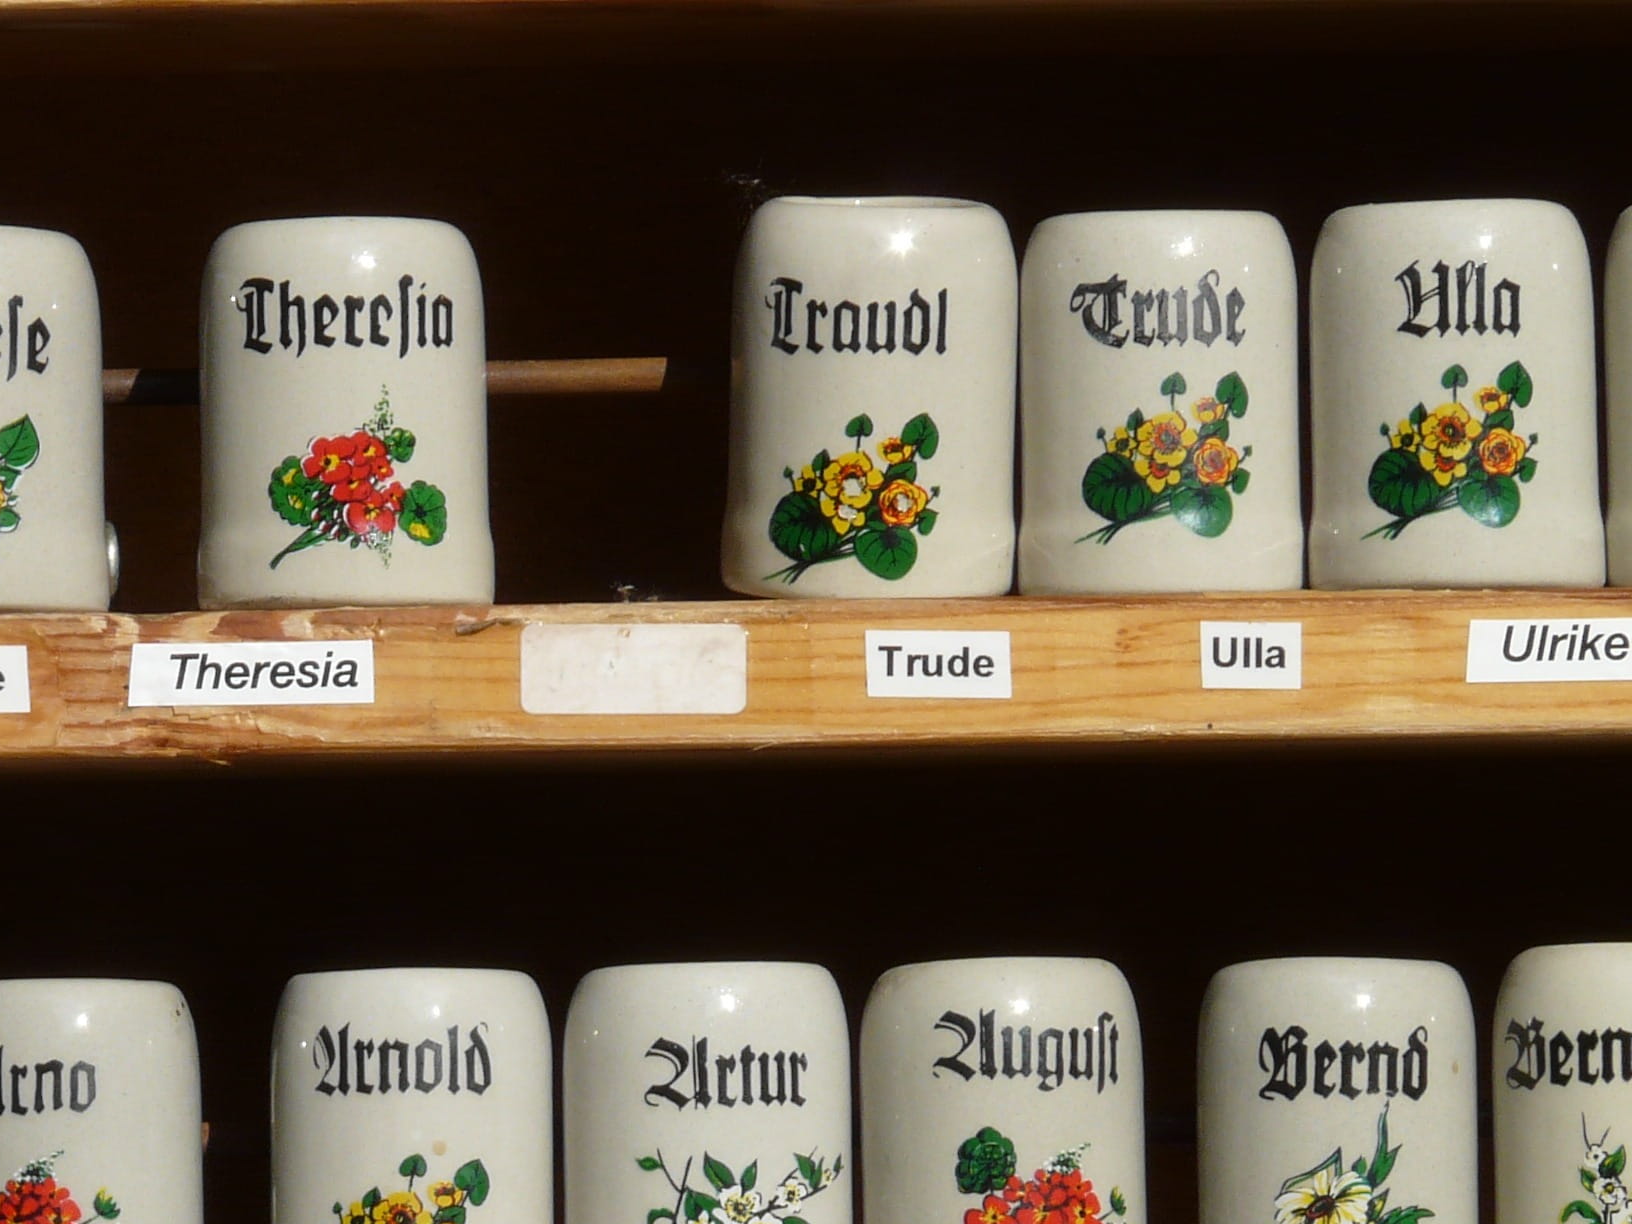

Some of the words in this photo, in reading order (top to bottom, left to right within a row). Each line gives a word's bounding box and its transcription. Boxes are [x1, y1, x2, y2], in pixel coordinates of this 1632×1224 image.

[766, 277, 947, 356] Traudl
[1069, 270, 1245, 349] Trude
[1395, 260, 1520, 338] Ulla
[170, 651, 358, 689] Theresia
[878, 646, 994, 677] Trude
[1213, 637, 1285, 668] Ulla
[1503, 625, 1629, 662] Ulrike
[313, 1023, 491, 1096] Arnold
[644, 1037, 807, 1111] Artur
[1259, 1026, 1427, 1103] Bernd
[1505, 1019, 1632, 1091] Bern
